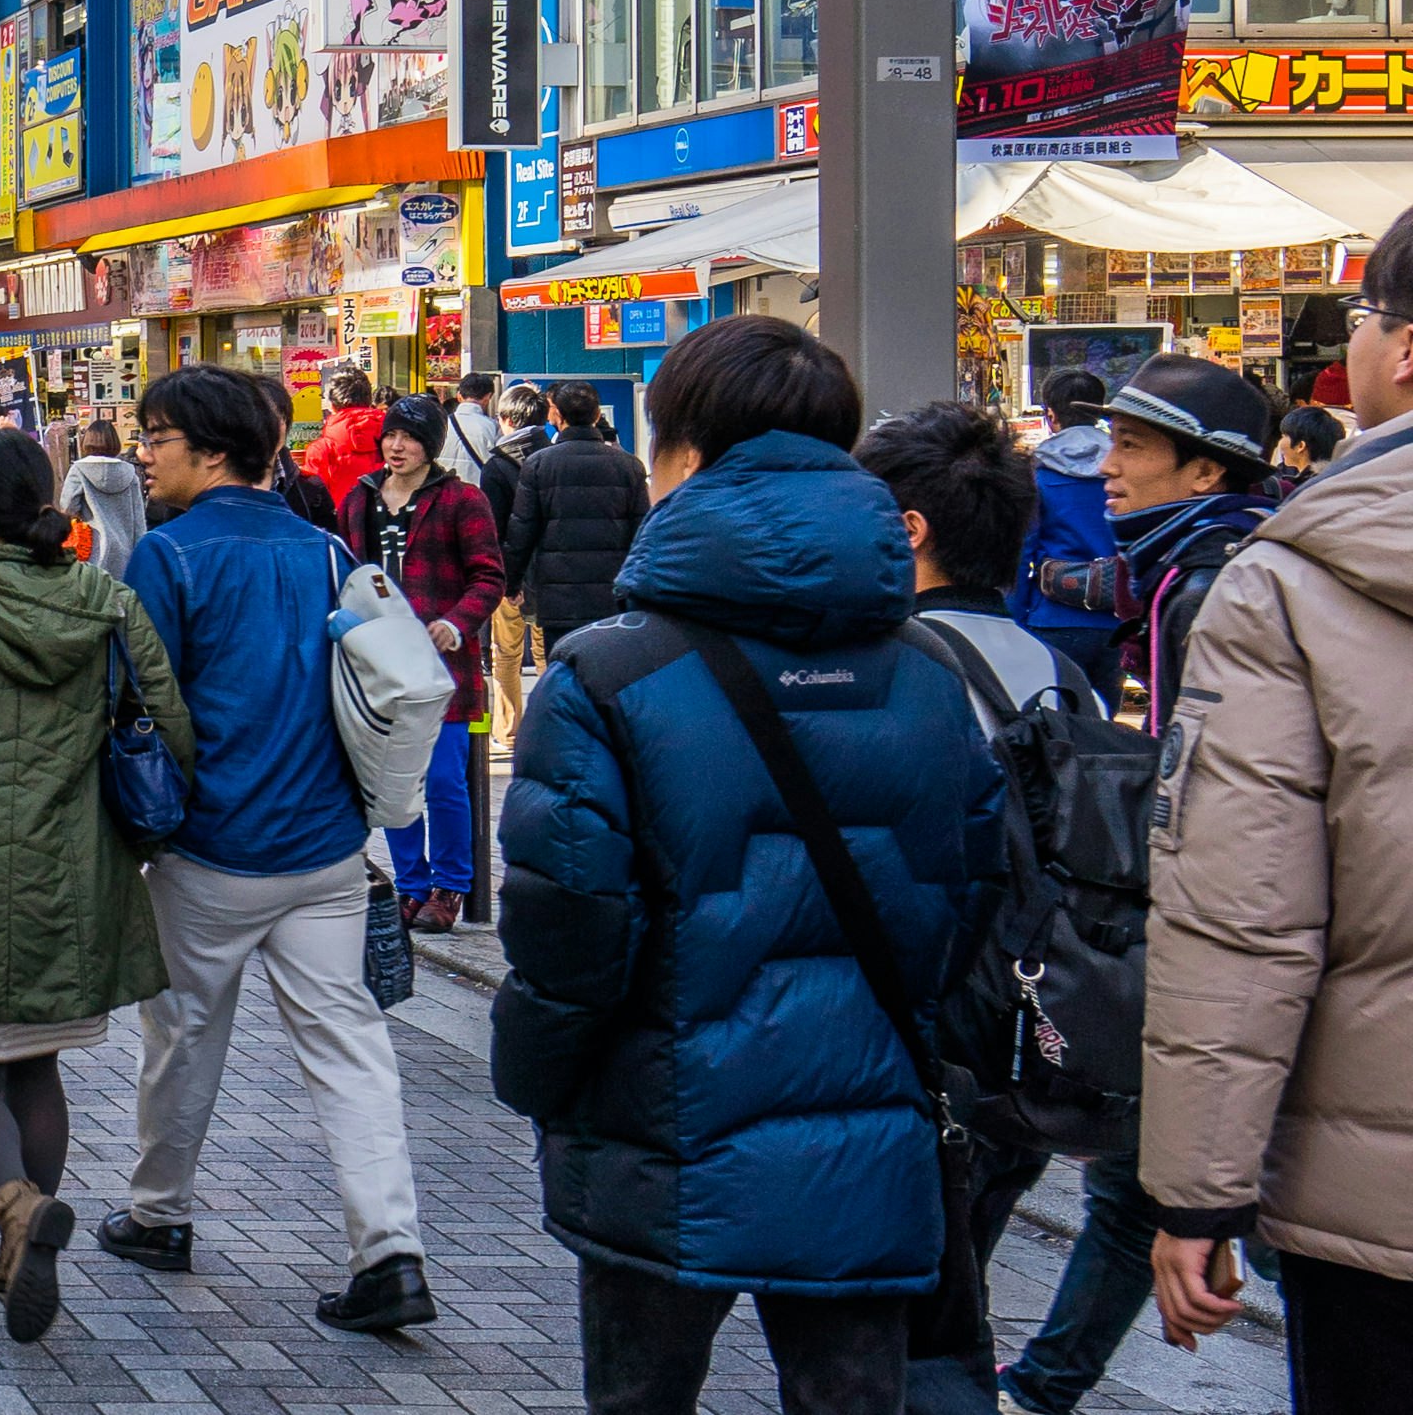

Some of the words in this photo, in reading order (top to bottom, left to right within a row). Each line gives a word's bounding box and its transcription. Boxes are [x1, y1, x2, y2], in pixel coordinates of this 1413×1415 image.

[2, 23, 15, 45] 2F
[973, 78, 1045, 114] 1.10
[991, 139, 1133, 157] 秋葉原駅前商店街振興組合
[516, 161, 536, 183] Real
[536, 158, 555, 179] Site
[405, 201, 457, 212] エスカレーター
[517, 201, 529, 223] 2F
[669, 203, 684, 217] Real
[685, 202, 700, 217] Site
[629, 309, 644, 320] OPEN
[794, 668, 855, 685] Columbia
